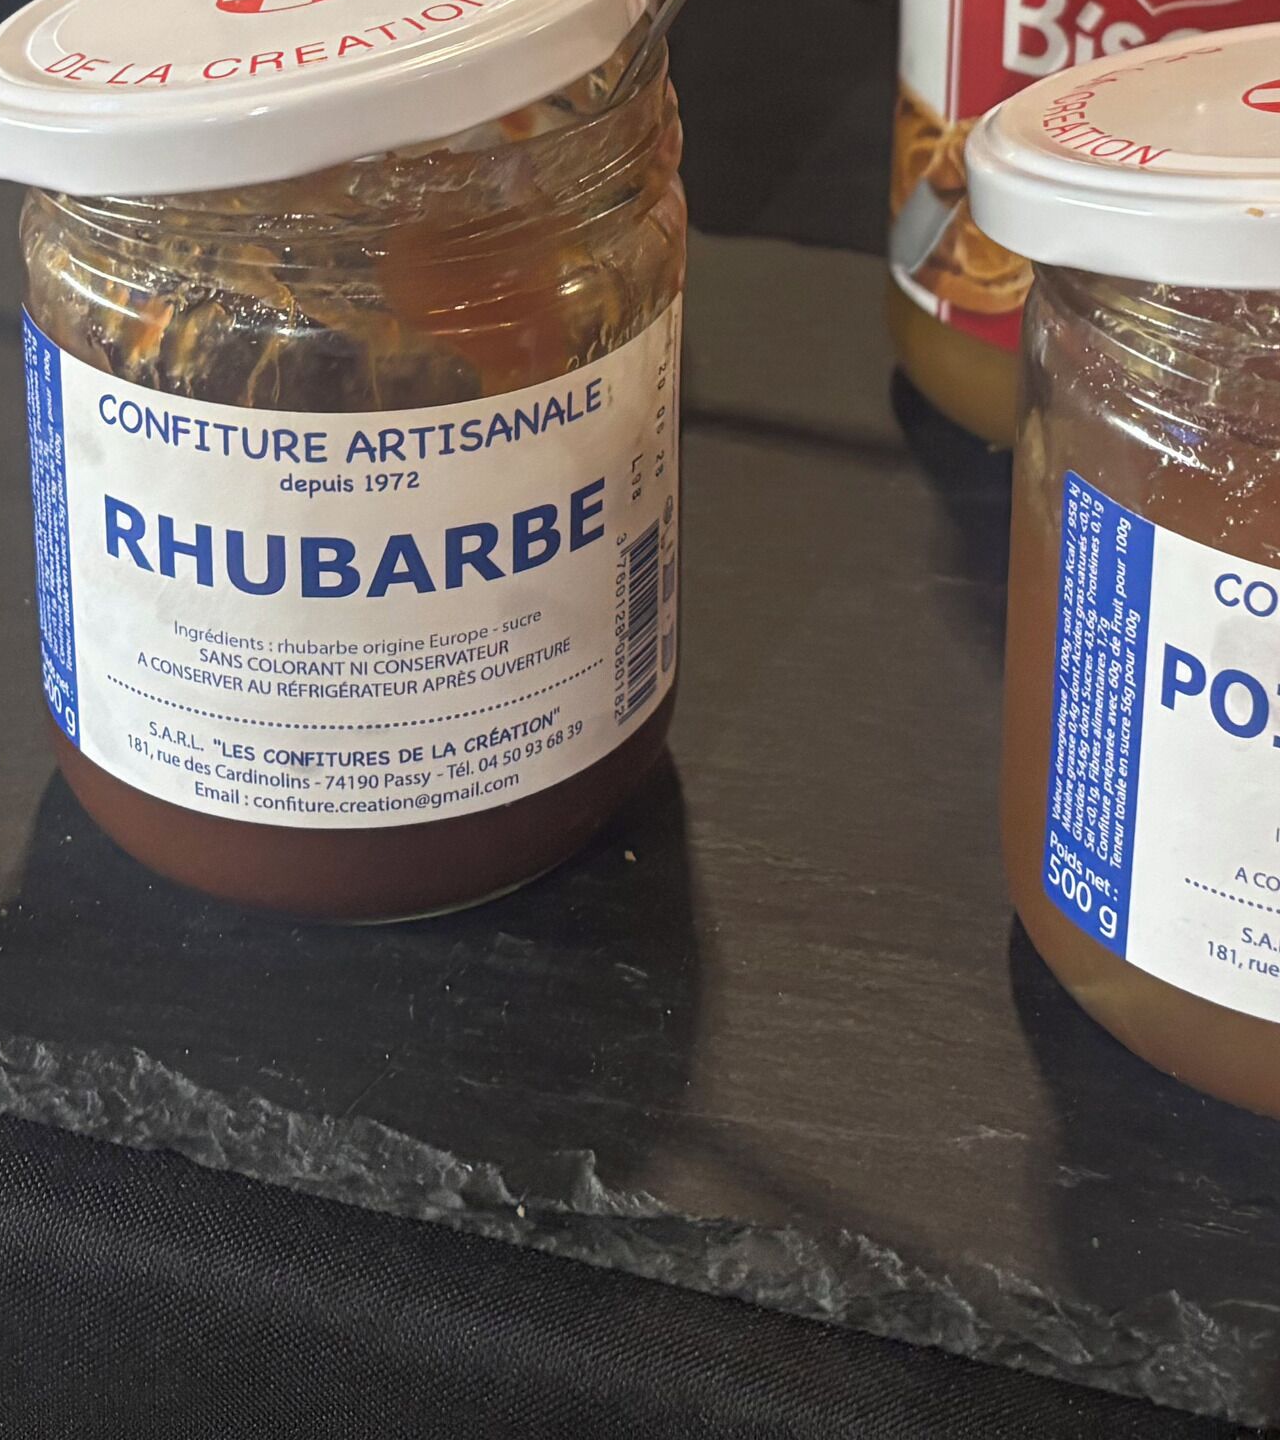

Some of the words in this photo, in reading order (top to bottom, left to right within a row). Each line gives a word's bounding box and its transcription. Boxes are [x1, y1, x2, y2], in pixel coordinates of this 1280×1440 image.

[45, 52, 109, 81] DE
[106, 63, 174, 87] LA
[1043, 91, 1172, 165] CREATION
[99, 394, 327, 463] CONFITURE
[346, 378, 602, 463] ARTISANALE
[280, 473, 354, 497] depuis
[366, 471, 419, 492] 1972
[104, 477, 605, 598] RHUBARBE
[1116, 517, 1131, 554] 100g
[1115, 558, 1127, 598] pour
[174, 621, 264, 651] Ingrédients
[278, 638, 358, 655] rhubarbe
[363, 638, 424, 656] origine
[430, 627, 488, 648] Europe
[502, 611, 541, 632] sucre
[1111, 598, 1124, 634] Fruit
[1125, 609, 1140, 645] 100g
[200, 648, 243, 669] SANS
[247, 657, 345, 676] COLORANT
[350, 662, 368, 675] NI
[373, 640, 509, 675] CONSERVATEUR
[1109, 636, 1121, 657] de
[138, 652, 148, 667] A
[151, 657, 243, 691] CONSERVER
[247, 679, 272, 695] AU
[277, 679, 418, 698] RÉFRIGÉRATEUR
[423, 670, 476, 693] APRÈS
[480, 637, 571, 681] OUVERTURE
[1108, 659, 1122, 689] 60g
[1125, 648, 1136, 687] pour
[1107, 691, 1118, 726] avec
[1121, 686, 1135, 716] 56g
[128, 734, 154, 760] 181,
[157, 750, 181, 767] rue
[185, 756, 211, 775] des
[215, 764, 310, 790] Cardinolins
[325, 774, 379, 790] 74190
[384, 771, 431, 788] Passy
[447, 761, 474, 779] Tél.
[479, 754, 498, 773] 04
[503, 747, 521, 765] 50
[525, 740, 543, 758] 93
[546, 730, 564, 749] 68
[567, 720, 583, 741] 39
[149, 721, 204, 751] S.A.R.L.
[213, 738, 255, 761] "LES
[263, 748, 391, 767] CONFITURES
[399, 747, 424, 764] DE
[432, 742, 456, 760] LA
[464, 707, 560, 753] CRÉATION"
[1120, 716, 1131, 756] sucre
[1102, 728, 1115, 795] préparée
[1118, 757, 1129, 777] en
[195, 781, 239, 804] Email
[253, 773, 519, 813] confiture.creation@gmail.com
[1114, 778, 1127, 820] totale
[1097, 795, 1111, 861] Confiture
[1109, 821, 1124, 869] Teneur
[1050, 830, 1083, 875] Poids
[1085, 867, 1111, 897] net
[1235, 867, 1248, 883] A
[1048, 853, 1092, 913] 500
[1099, 905, 1118, 939] g
[1207, 941, 1243, 969] 181,
[1249, 957, 1280, 977] rue
